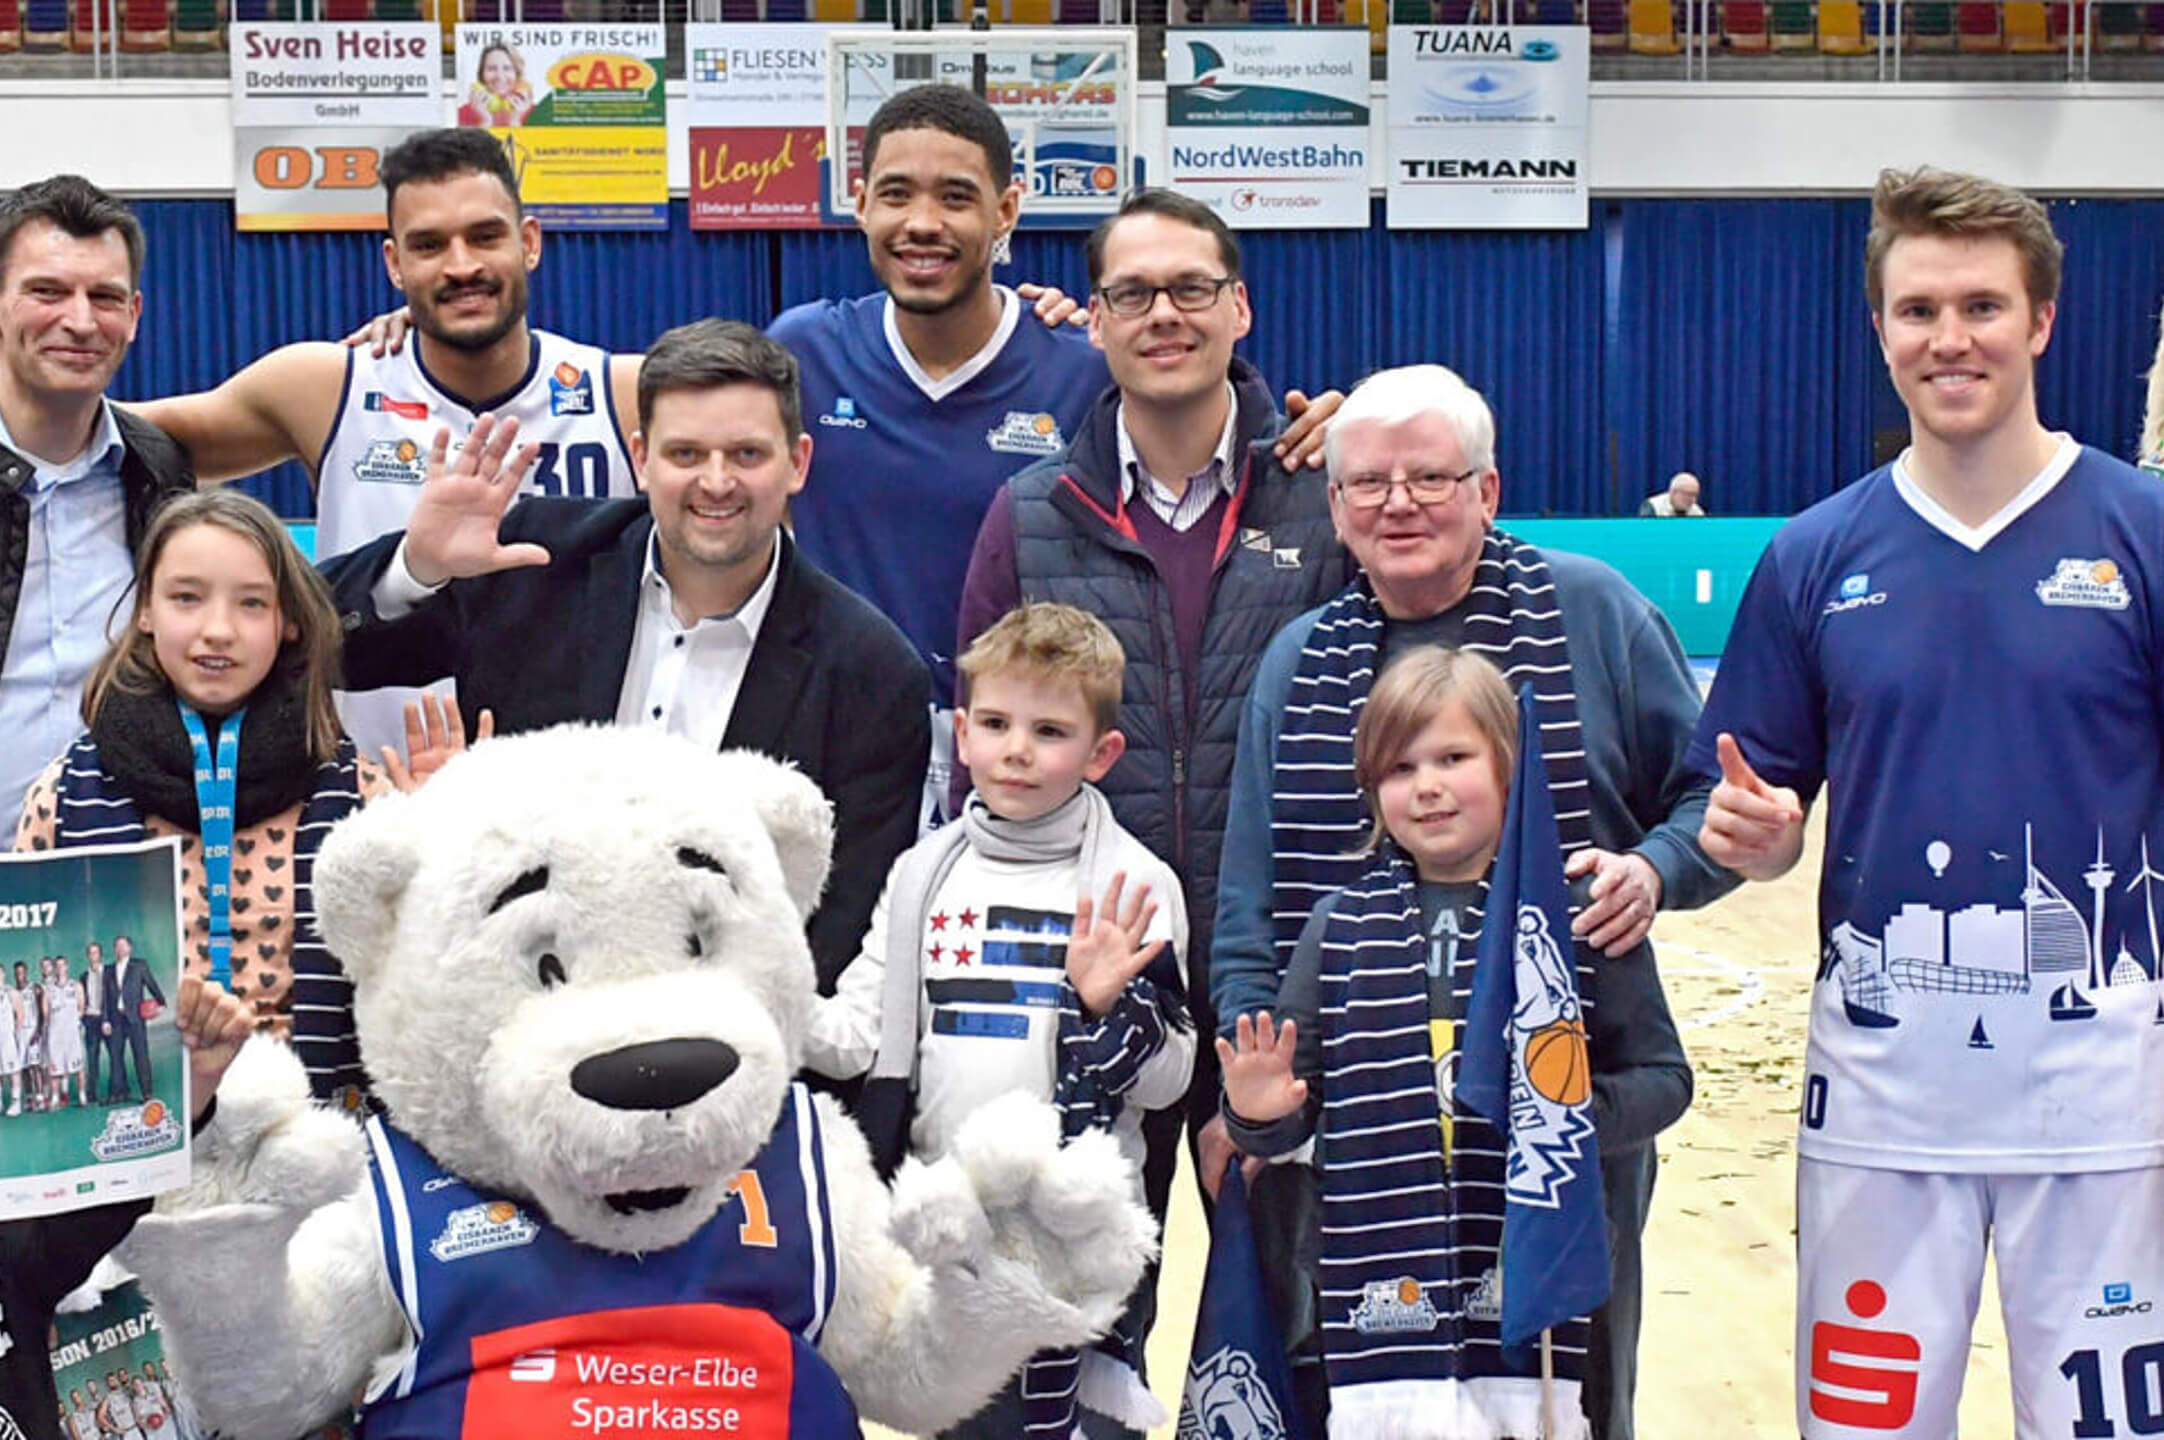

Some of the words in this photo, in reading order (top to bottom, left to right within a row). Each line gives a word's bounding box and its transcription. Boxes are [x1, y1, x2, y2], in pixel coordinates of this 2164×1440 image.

[245, 30, 321, 59] Sven
[337, 29, 427, 62] Heise
[463, 31, 503, 46] WIR
[512, 30, 563, 46] SIND
[571, 30, 658, 46] FRISCH!
[1232, 39, 1275, 55] haven
[1415, 31, 1513, 54] TUANA
[732, 50, 817, 68] FLIESEN
[1232, 62, 1302, 78] language
[1305, 60, 1353, 76] school
[246, 71, 428, 91] Bodenverlegungen
[559, 60, 642, 90] CAP
[315, 104, 360, 117] GmbH
[1173, 143, 1364, 168] NordWestBahn
[1400, 159, 1577, 178] TIEMANN
[517, 442, 610, 500] 30
[0, 902, 58, 928] 2017
[576, 1355, 759, 1388] Weser-Elbe
[2059, 1341, 2164, 1439] 10
[570, 1398, 741, 1434] Sparkasse
